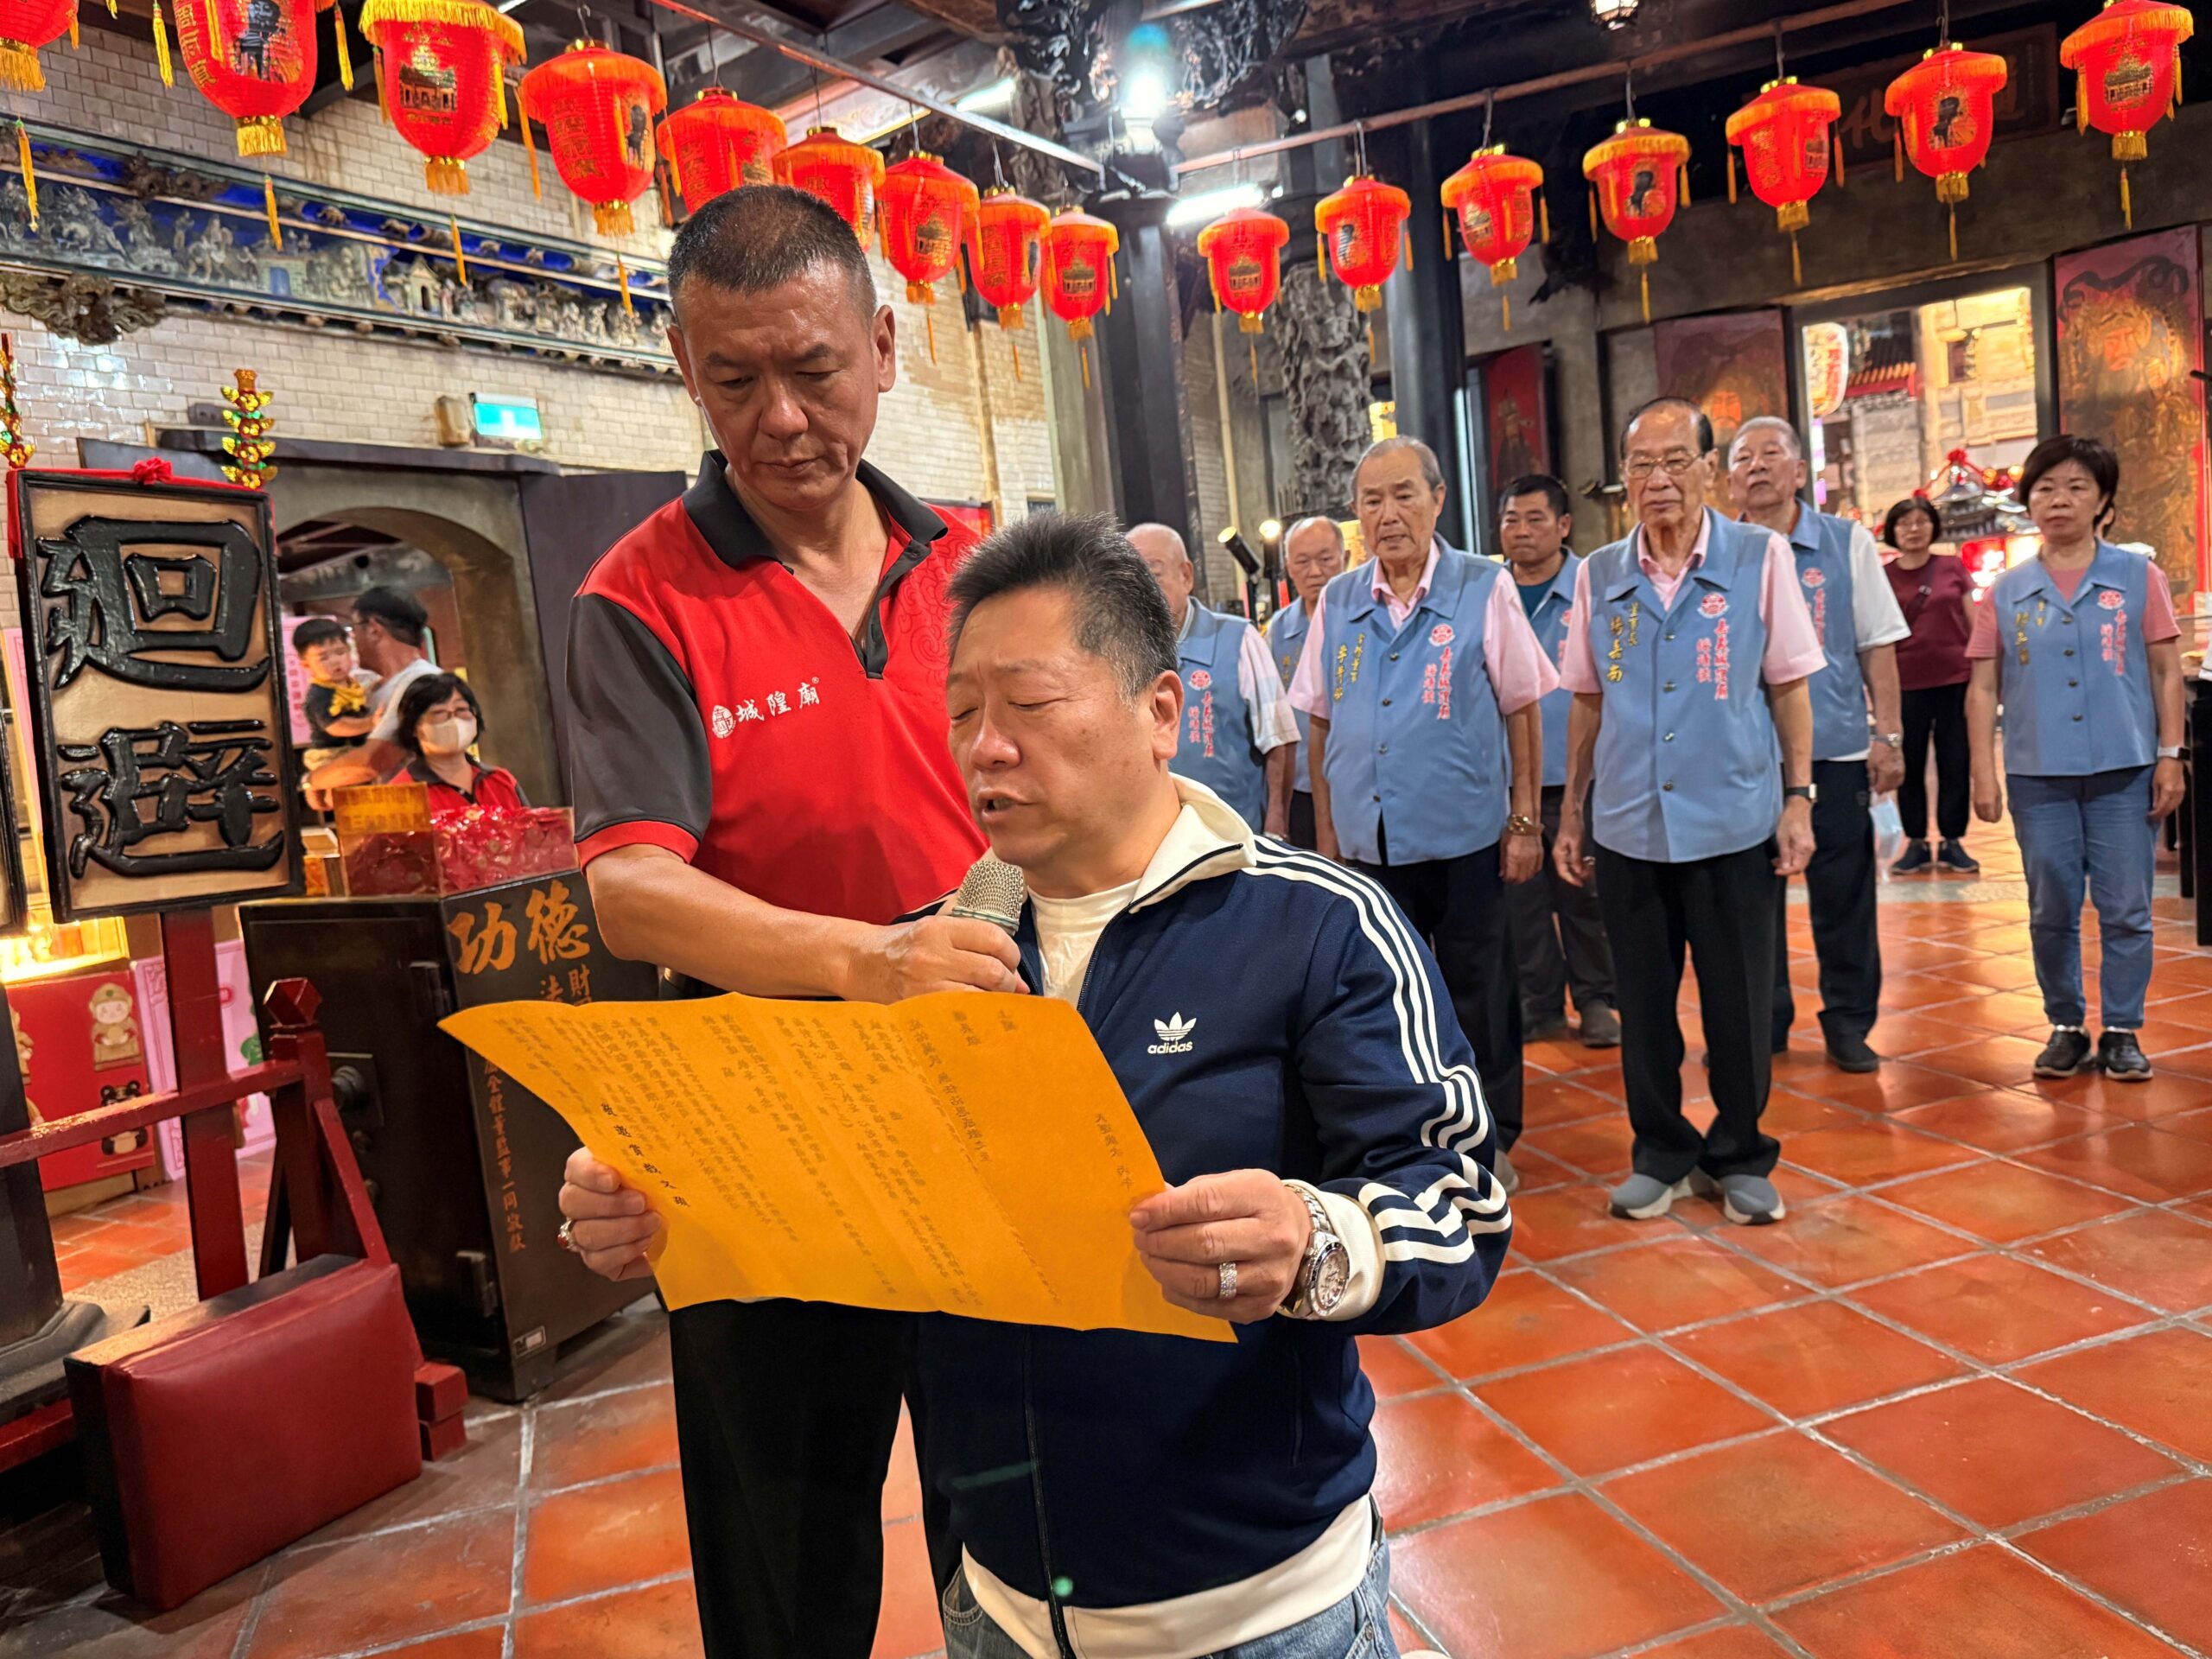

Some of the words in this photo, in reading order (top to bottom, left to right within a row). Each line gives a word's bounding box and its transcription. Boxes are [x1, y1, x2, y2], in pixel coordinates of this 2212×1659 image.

[36, 516, 284, 880] 迴避
[734, 682, 820, 723] 城隍廟
[1147, 1040, 1193, 1054] adidas
